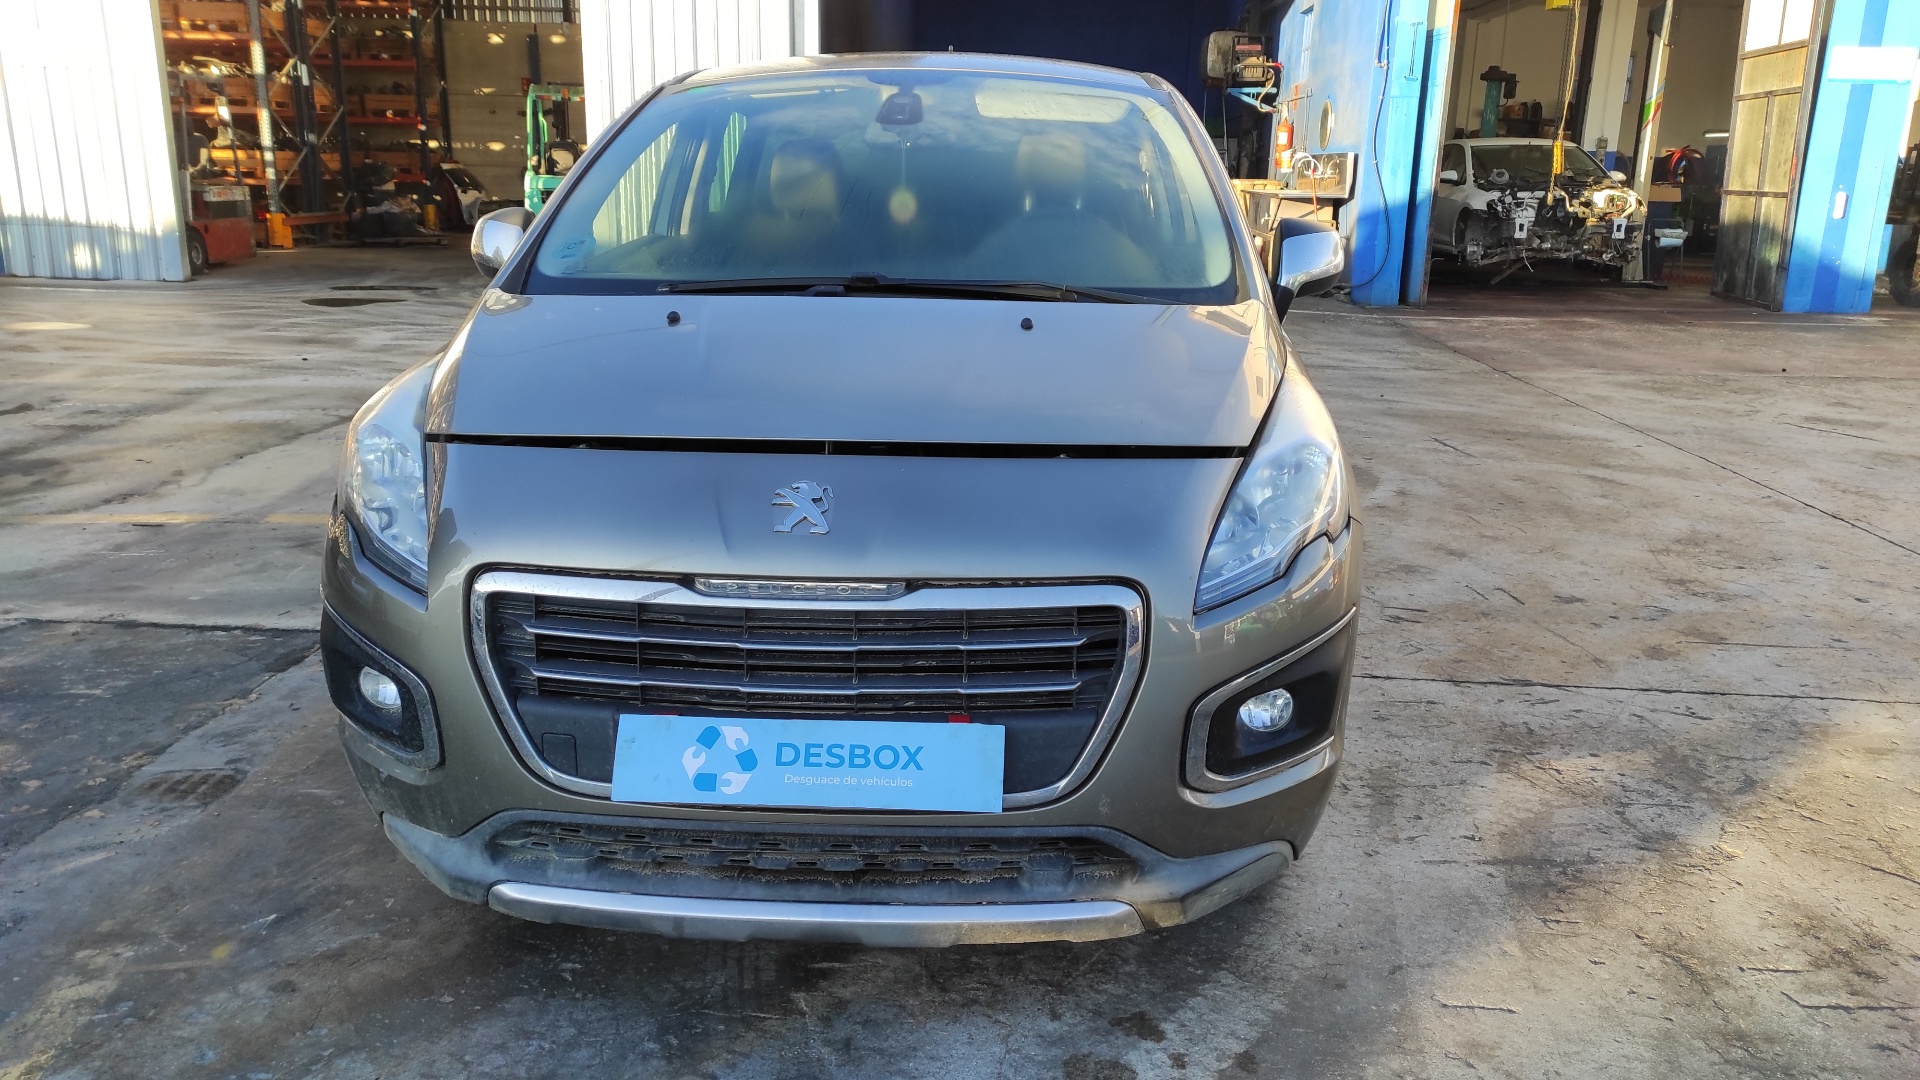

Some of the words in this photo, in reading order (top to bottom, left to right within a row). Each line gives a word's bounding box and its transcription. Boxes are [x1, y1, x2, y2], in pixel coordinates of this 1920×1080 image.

[726, 582, 873, 595] PEUGEOT
[775, 742, 924, 771] DESBOX
[784, 773, 841, 786] Desguace
[843, 775, 858, 785] de
[860, 776, 913, 787] vehículos
